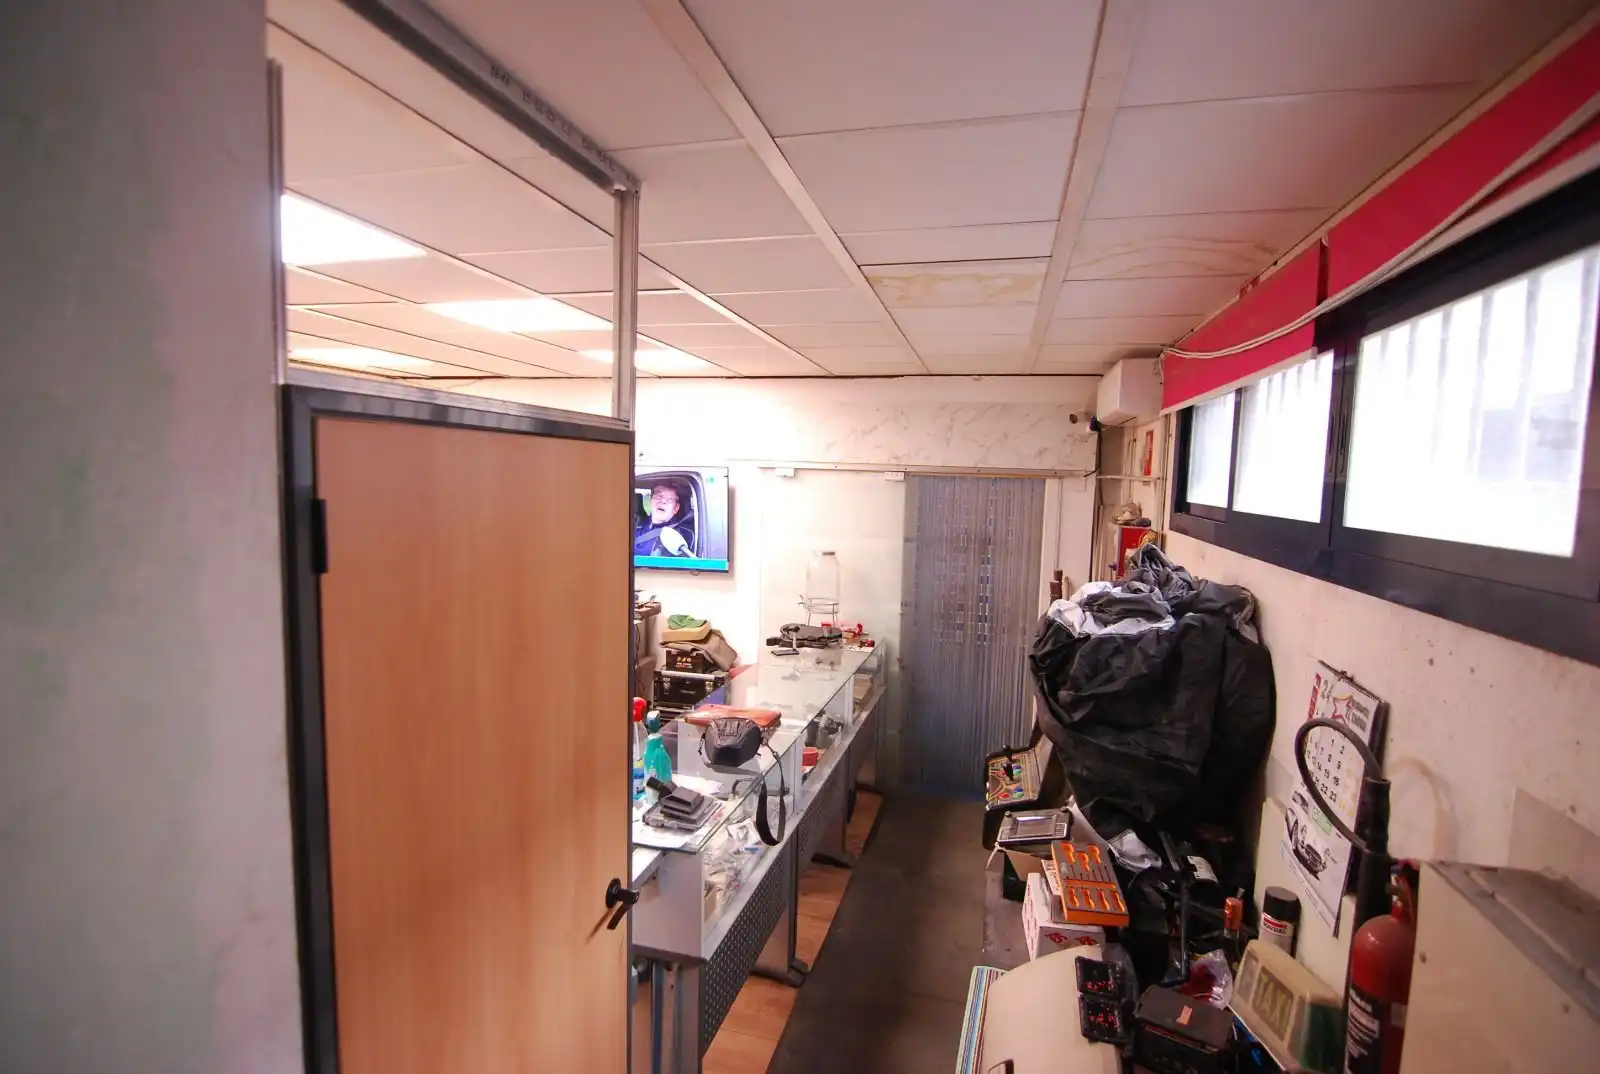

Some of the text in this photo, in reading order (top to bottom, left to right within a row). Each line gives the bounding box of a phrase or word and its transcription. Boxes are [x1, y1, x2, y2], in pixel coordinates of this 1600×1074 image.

[1320, 783, 1328, 795] 22
[1329, 791, 1337, 802] 23
[1256, 972, 1293, 1034] TAXI
